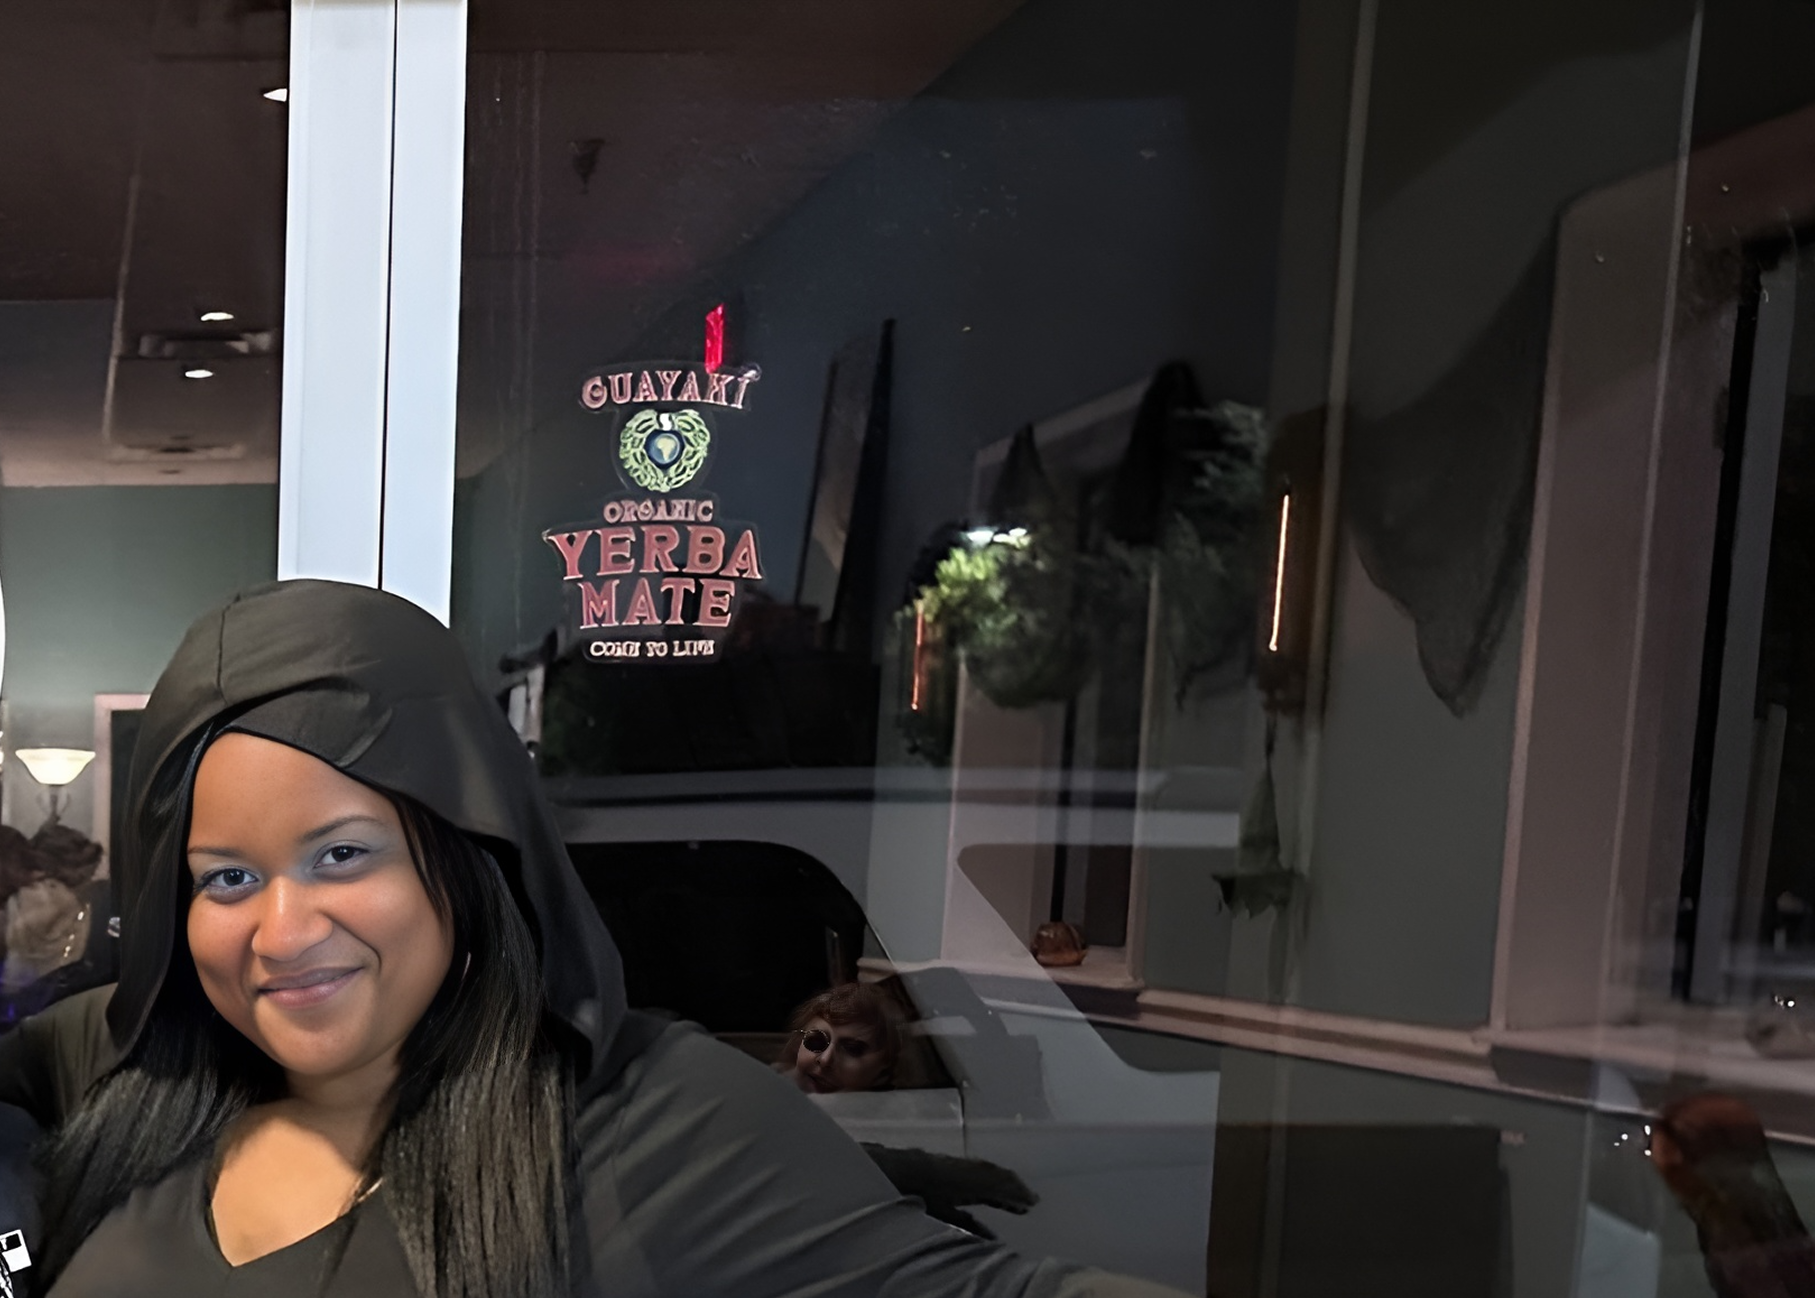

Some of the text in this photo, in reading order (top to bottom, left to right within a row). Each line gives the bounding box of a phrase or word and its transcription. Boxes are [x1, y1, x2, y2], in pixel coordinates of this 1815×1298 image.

[603, 499, 714, 523] ORGANIC
[546, 525, 762, 580] YERBA
[578, 577, 735, 629] MATE
